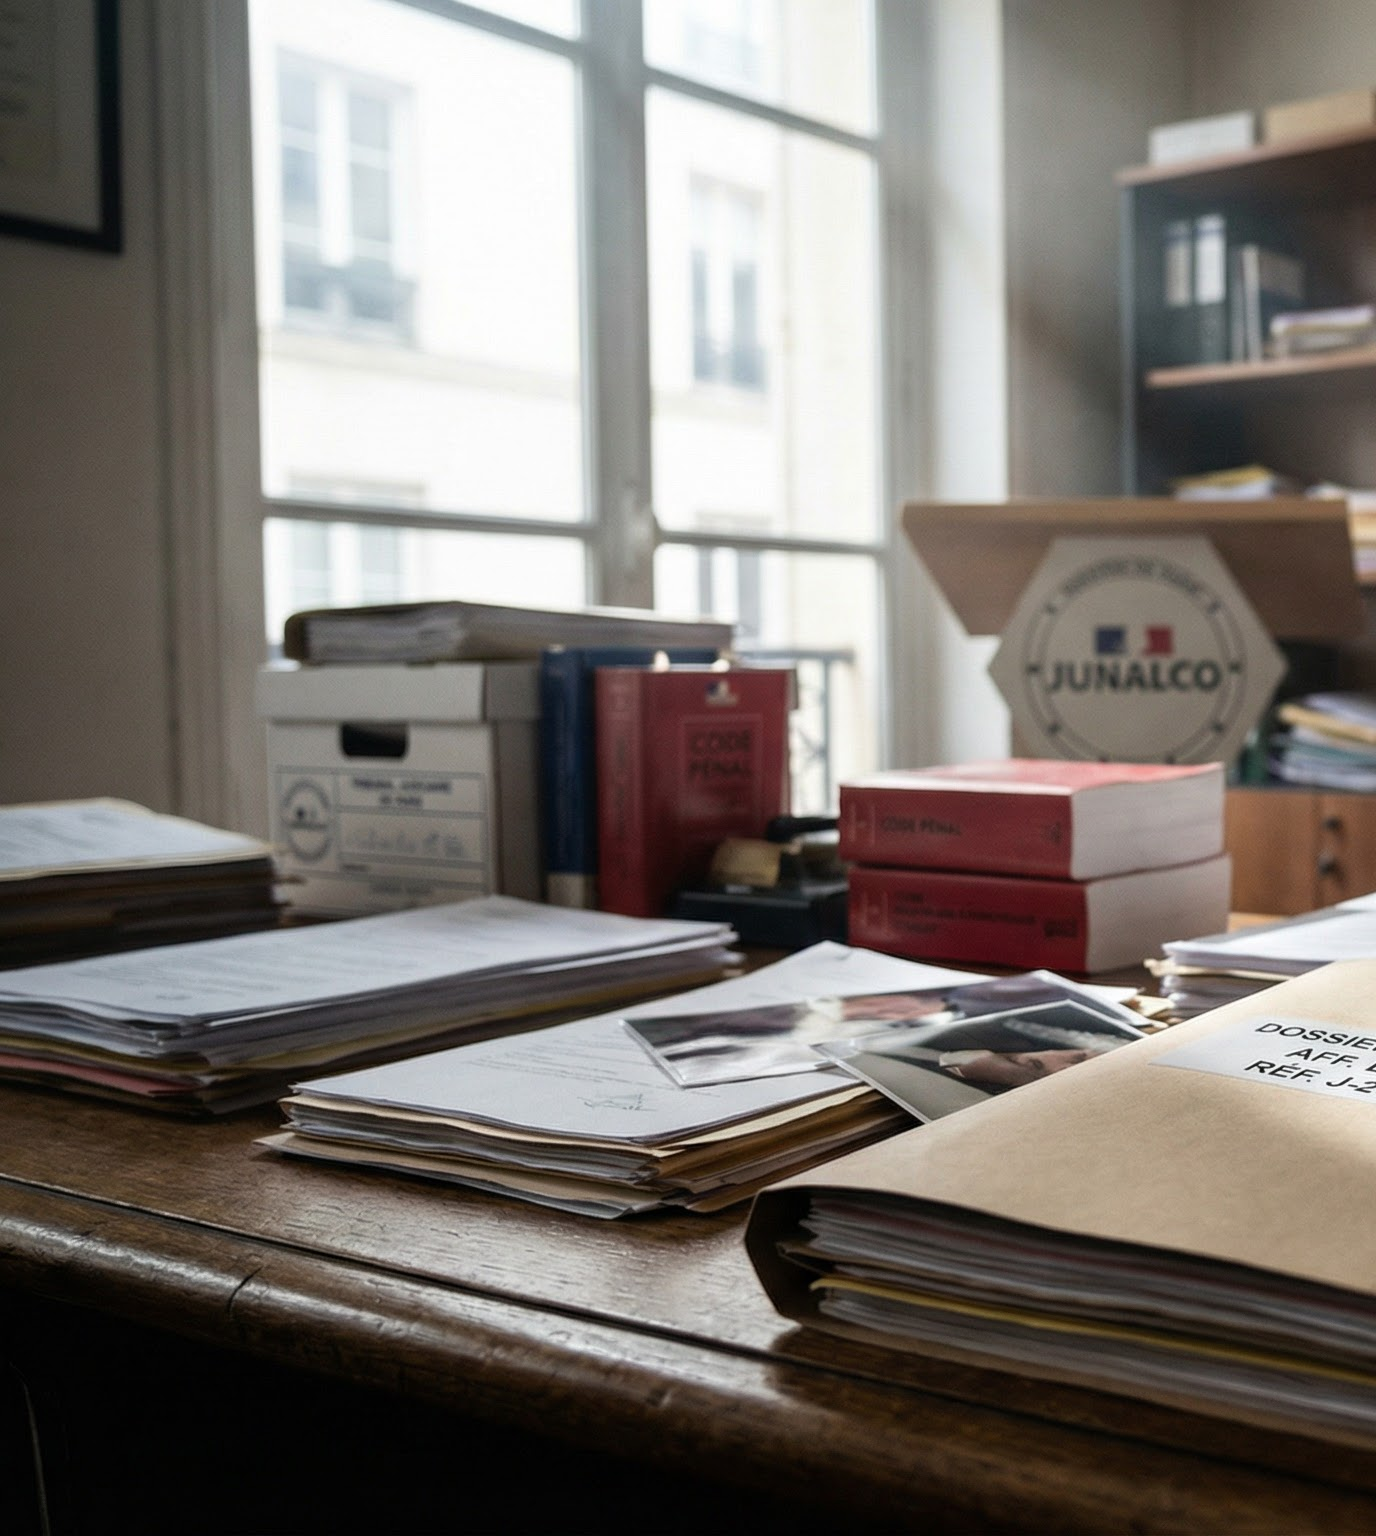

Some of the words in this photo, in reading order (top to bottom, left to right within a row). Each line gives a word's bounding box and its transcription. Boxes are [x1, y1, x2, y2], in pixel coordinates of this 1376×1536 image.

[1047, 660, 1223, 692] JUNALCO
[1285, 1048, 1359, 1068] AFF.
[1244, 1060, 1321, 1083] RÉF.
